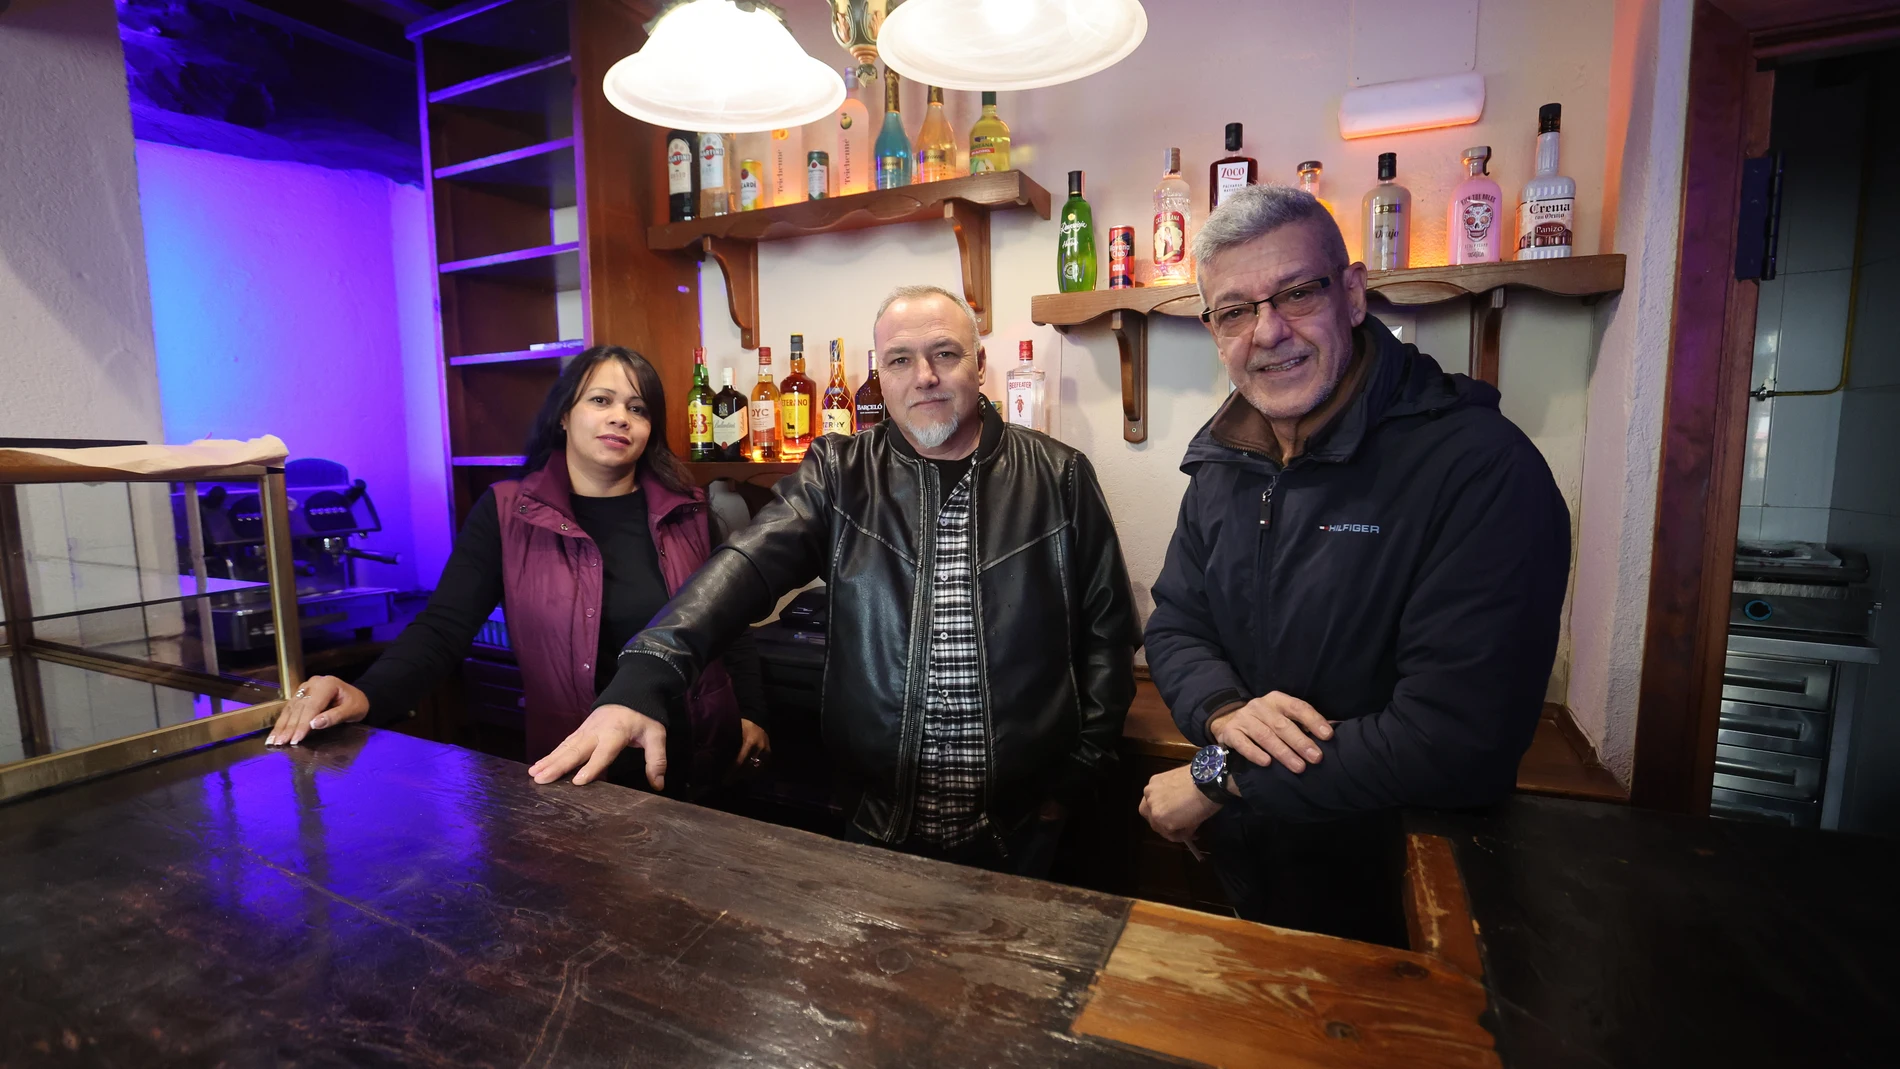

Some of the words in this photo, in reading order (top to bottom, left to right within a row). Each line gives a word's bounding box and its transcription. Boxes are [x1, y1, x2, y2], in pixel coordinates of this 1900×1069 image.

[1221, 167, 1245, 180] ZOCO
[1529, 203, 1570, 214] Crema
[1375, 229, 1399, 240] Oujo
[1009, 381, 1032, 390] BEEFEATER
[781, 399, 808, 407] ETERANO
[857, 402, 883, 411] BARCELÓ
[823, 421, 845, 429] ERRY
[1329, 523, 1380, 534] HILFIGER
